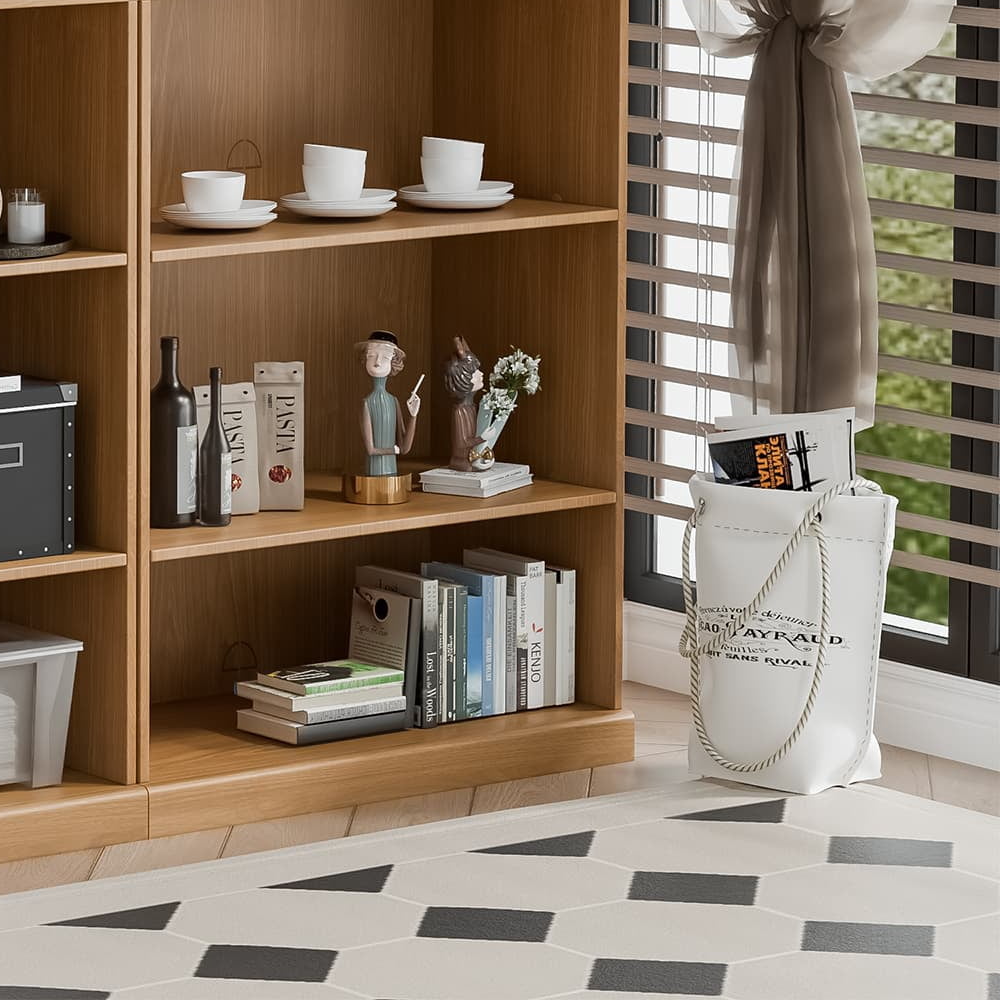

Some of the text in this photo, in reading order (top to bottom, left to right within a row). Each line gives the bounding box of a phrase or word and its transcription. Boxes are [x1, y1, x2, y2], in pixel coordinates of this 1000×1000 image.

[276, 396, 296, 453] PASTA
[769, 436, 784, 486] ЭЛИТА
[426, 651, 436, 673] Lost
[531, 642, 542, 683] KENJO
[725, 652, 759, 662] SANS
[764, 657, 813, 669] RIVAL
[426, 688, 437, 722] Woods
